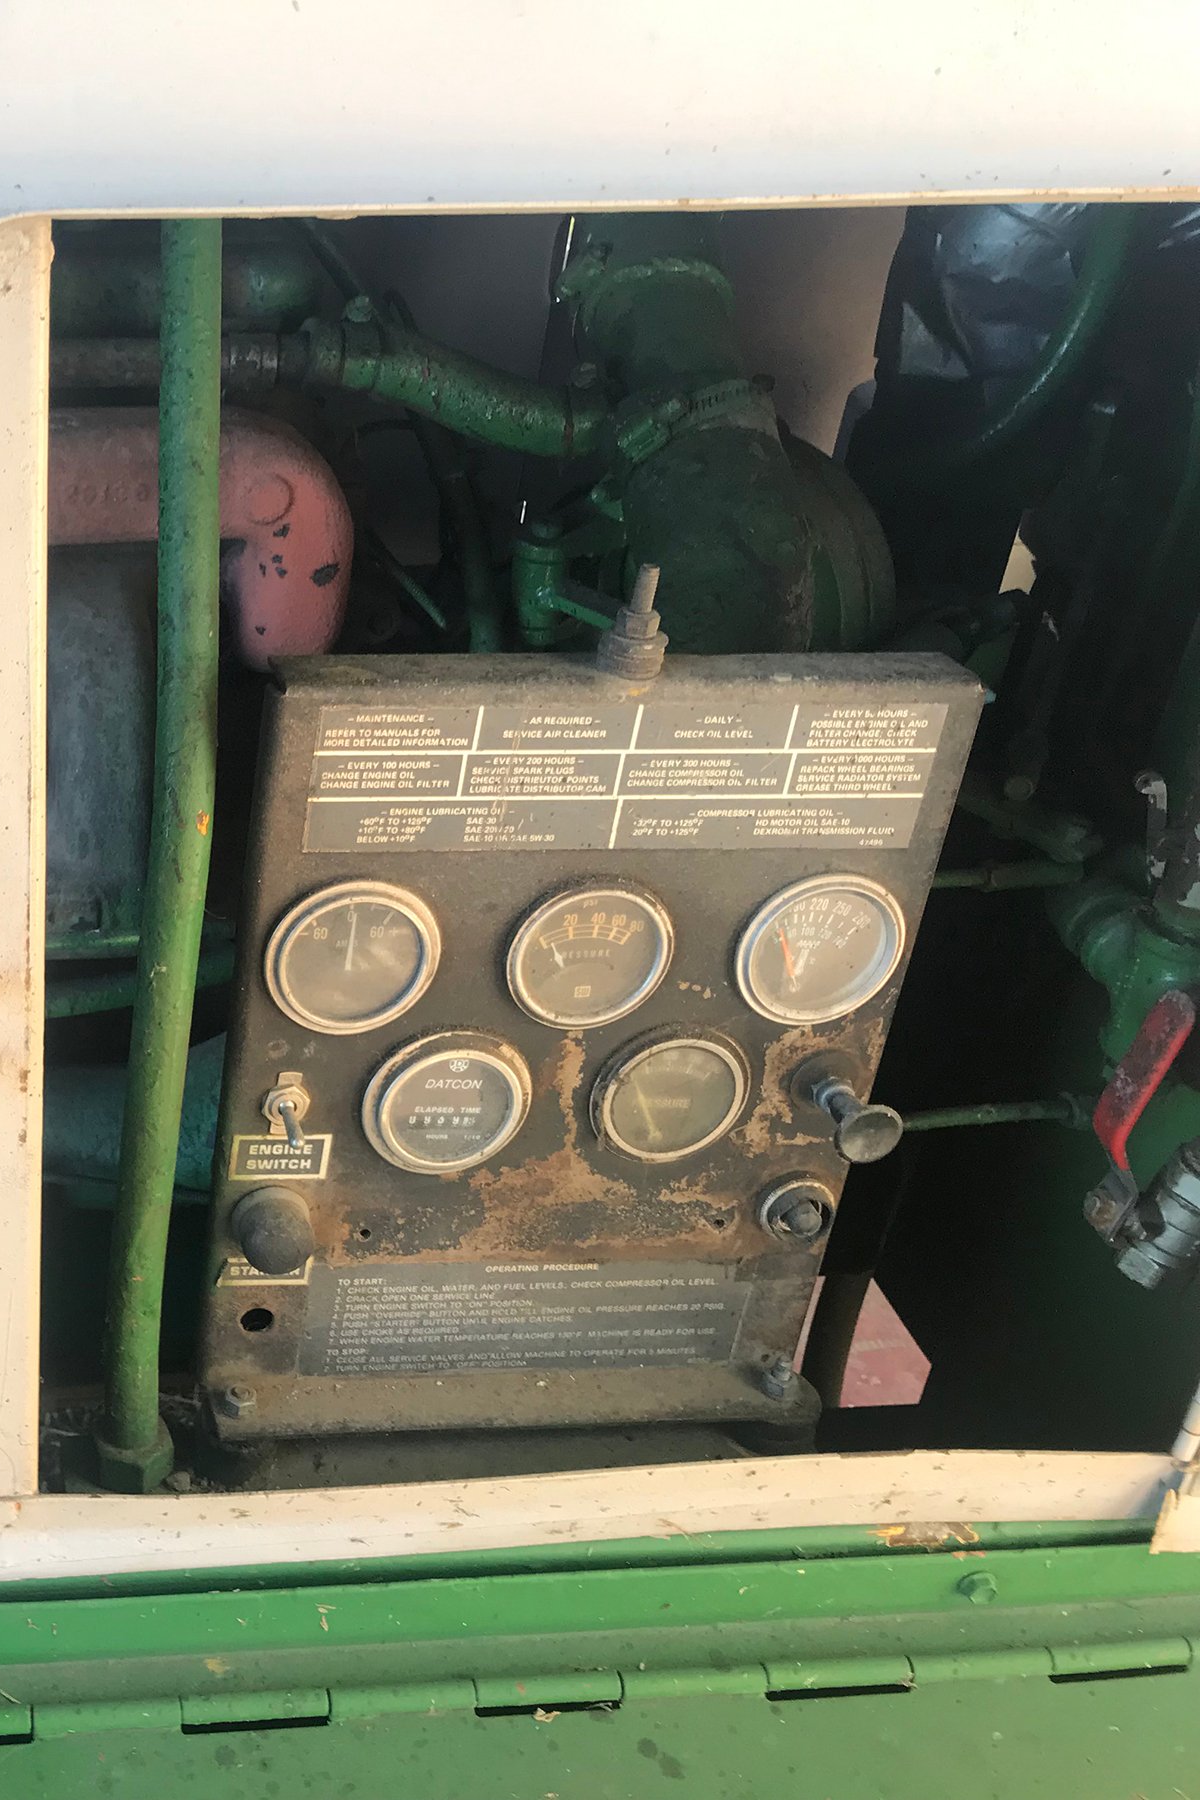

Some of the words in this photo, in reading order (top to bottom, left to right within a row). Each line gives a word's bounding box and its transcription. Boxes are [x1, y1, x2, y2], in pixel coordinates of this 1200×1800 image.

[832, 710, 864, 718] EVERY
[704, 716, 734, 724] DAILY
[811, 720, 852, 728] POSSIBLE
[908, 720, 928, 728] AND
[325, 729, 356, 737] REFER
[359, 729, 371, 737] TO
[374, 729, 419, 737] MANUALS
[503, 730, 542, 738] SERVICE
[544, 730, 561, 738] AIR
[563, 730, 607, 738] CLEANER
[674, 730, 705, 738] CHECK
[706, 730, 722, 738] OIL
[725, 730, 753, 738] LEVEL
[323, 739, 350, 747] MORE
[402, 738, 468, 746] INFORMATION
[806, 739, 848, 747] BATTERY
[493, 757, 525, 765] EVERY
[875, 755, 906, 763] HOURS
[382, 761, 397, 769] 100
[399, 761, 431, 769] HOURS
[650, 760, 680, 768] EVERY
[801, 766, 835, 774] REPACK
[837, 765, 867, 773] WHEEL
[869, 765, 915, 773] BEARINGS
[322, 772, 359, 780] CHANGE
[629, 770, 667, 778] CHANGE
[838, 774, 884, 782] RADIATOR
[886, 774, 921, 782] SYSTEM
[470, 776, 501, 784] CHECK
[627, 779, 664, 787] CHANGE
[667, 779, 725, 787] COMPRESSOR
[745, 778, 777, 786] FILTER
[320, 781, 358, 789] CHANGE
[416, 780, 449, 788] FILTER
[796, 784, 831, 792] GREASE
[863, 783, 892, 791] WHEEL
[697, 809, 755, 817] COMPRESSOR
[757, 809, 817, 817] LUBRICATING
[819, 809, 834, 817] OIL
[660, 819, 672, 827] TO
[770, 819, 801, 827] MOTOR
[386, 826, 398, 834] TO
[656, 828, 668, 836] TO
[356, 836, 388, 844] BELOW
[810, 898, 829, 910] 220
[564, 914, 578, 926] 20
[591, 913, 606, 924] 40
[612, 915, 626, 926] 60
[425, 1080, 483, 1089] DATCON
[246, 1159, 311, 1170] SWITCH
[485, 1265, 538, 1273] OPERATING
[382, 1286, 418, 1294] ENGINE
[605, 1280, 669, 1288] COMPRESSOR
[373, 1303, 407, 1311] ENGINE
[410, 1302, 446, 1310] SWITCH
